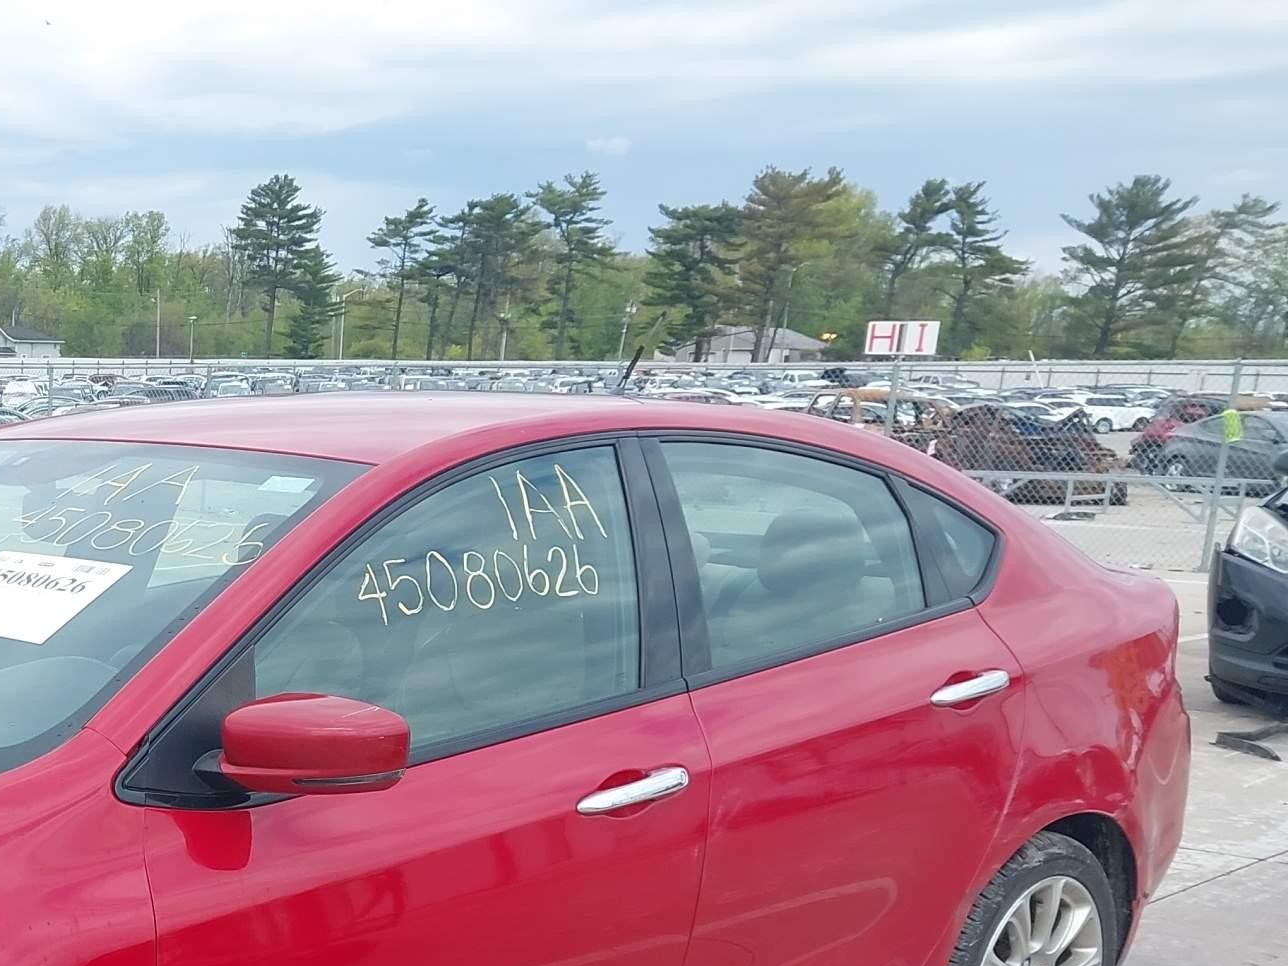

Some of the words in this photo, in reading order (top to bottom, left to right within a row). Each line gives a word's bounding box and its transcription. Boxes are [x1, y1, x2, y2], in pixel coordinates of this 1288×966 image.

[55, 463, 201, 505] IAA
[488, 463, 608, 541] IAA
[358, 543, 600, 626] 45080626
